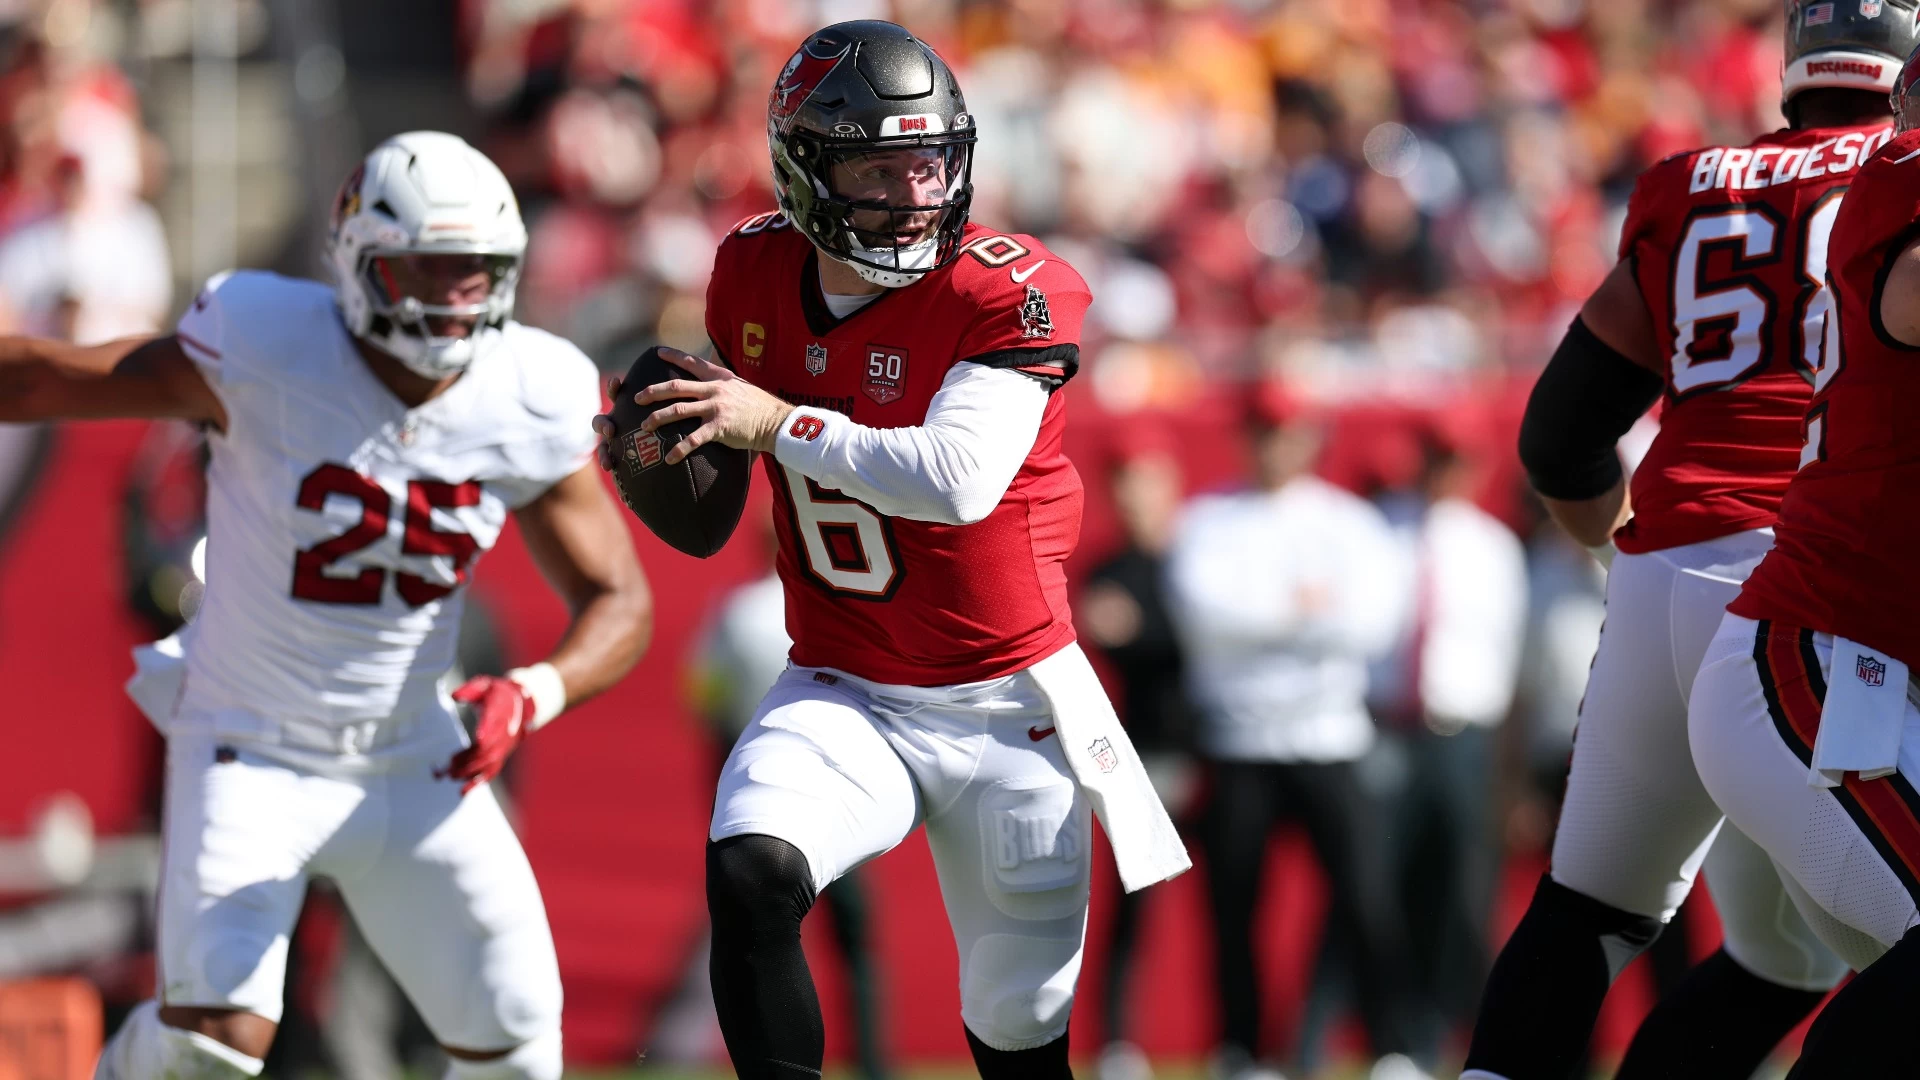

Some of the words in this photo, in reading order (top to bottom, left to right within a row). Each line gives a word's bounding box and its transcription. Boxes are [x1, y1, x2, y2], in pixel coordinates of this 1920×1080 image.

[900, 117, 927, 132] BUCS
[1689, 127, 1894, 194] BREDESO
[743, 322, 765, 358] C
[808, 356, 823, 370] NFL
[869, 352, 901, 380] 50
[292, 461, 482, 607] 25
[782, 464, 904, 601] 6
[1858, 667, 1880, 685] NFL
[1095, 751, 1115, 770] NFL
